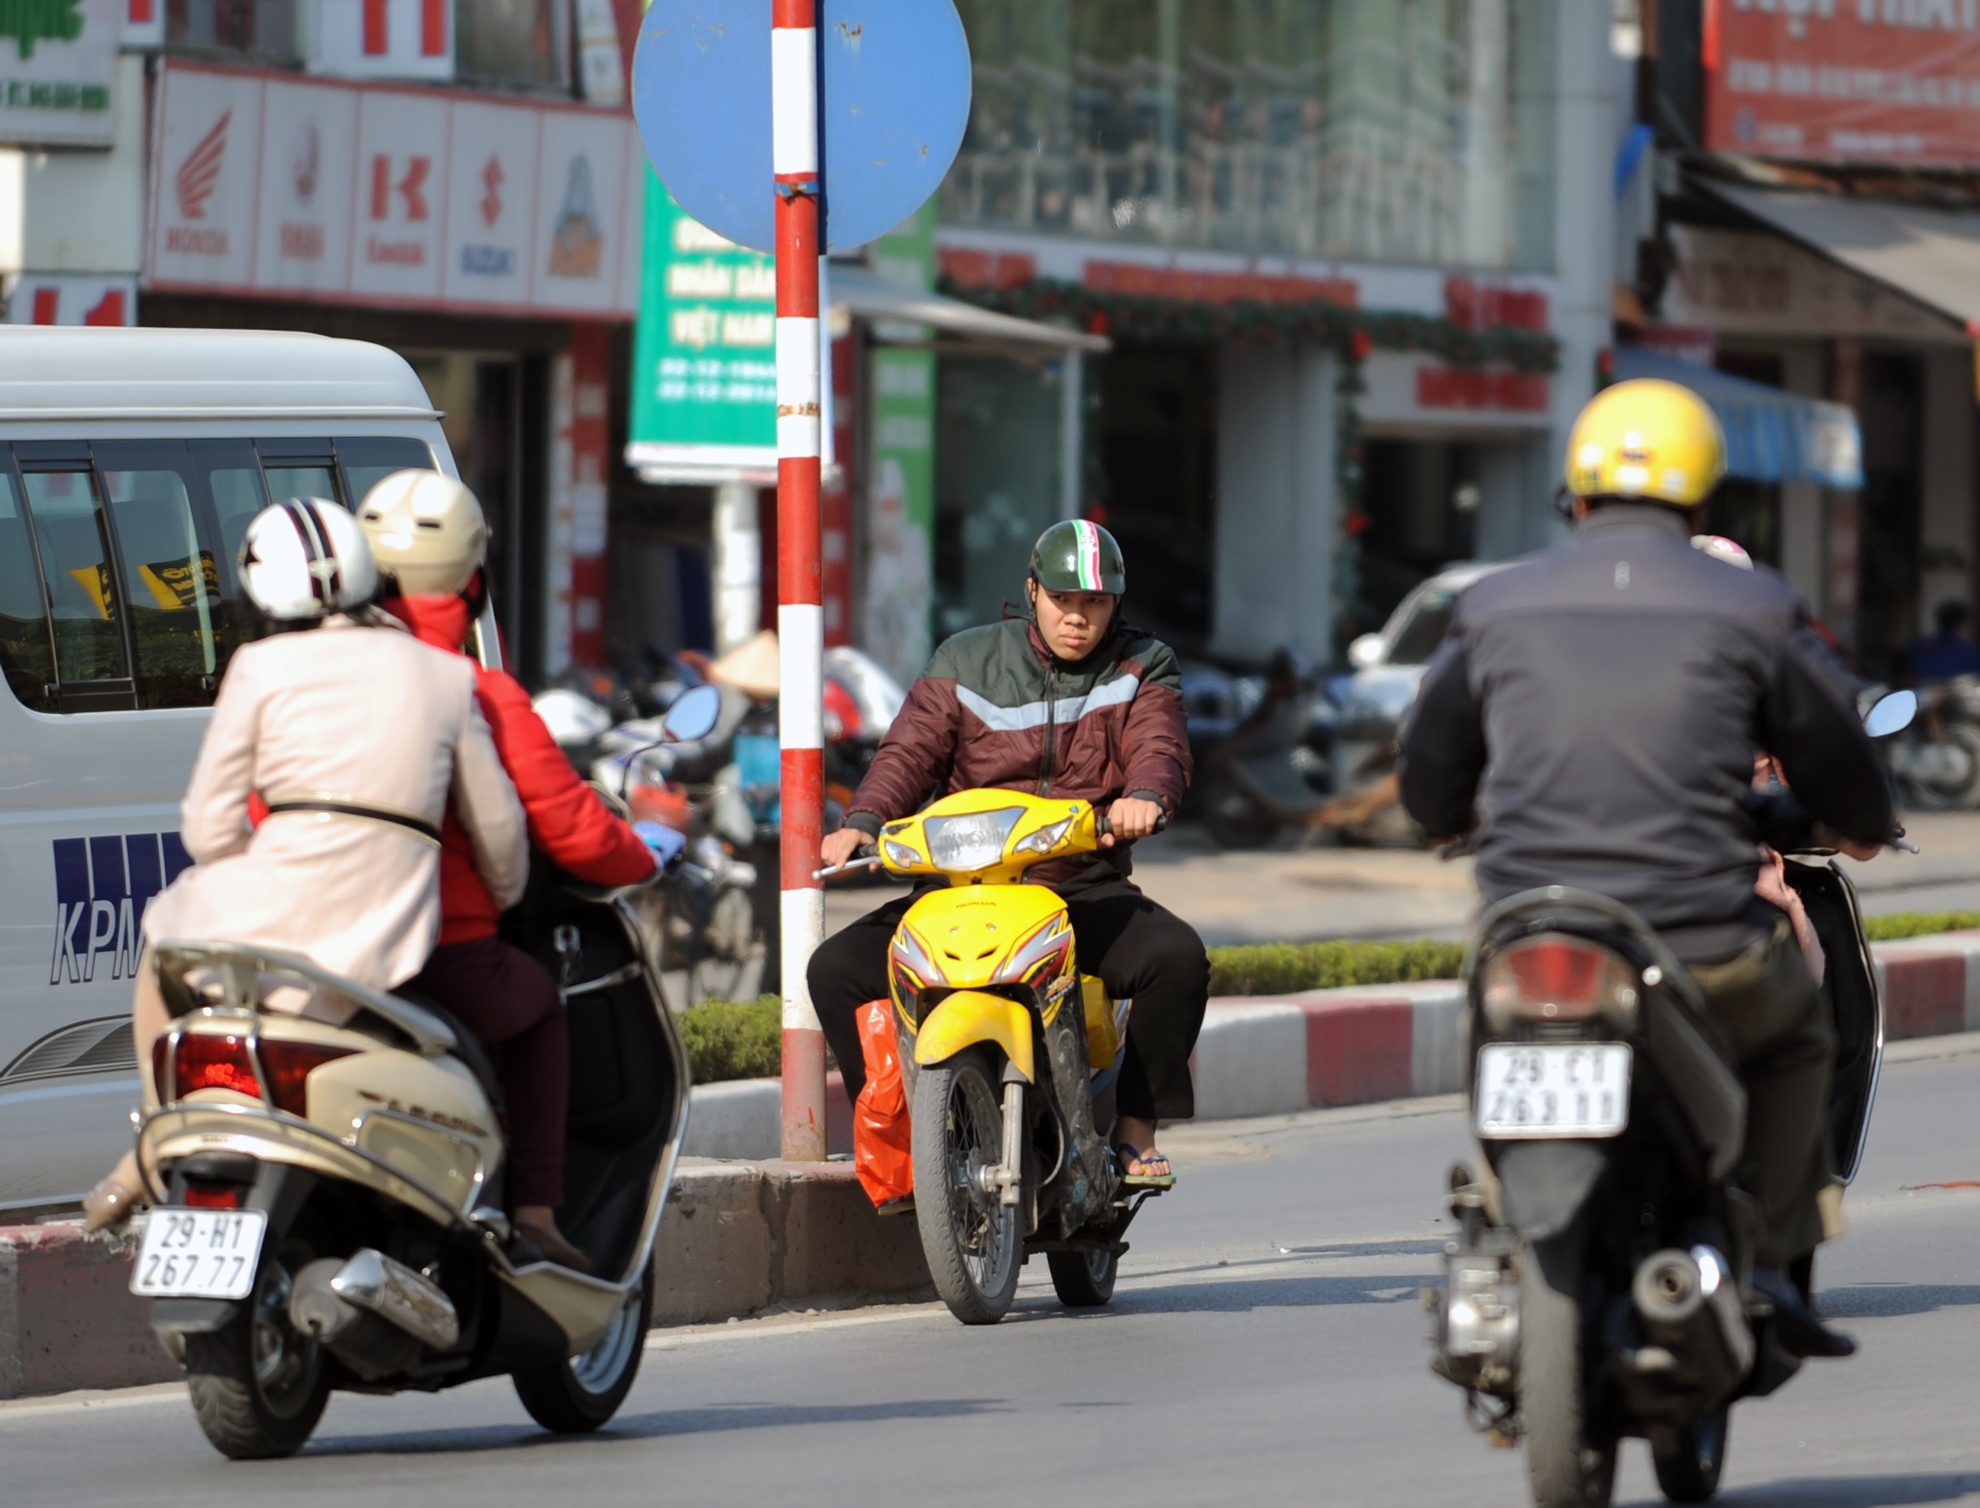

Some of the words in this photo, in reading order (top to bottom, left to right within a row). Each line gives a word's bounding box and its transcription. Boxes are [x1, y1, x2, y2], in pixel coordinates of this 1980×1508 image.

[723, 311, 775, 347] NAM
[160, 1214, 243, 1250] 29-H1
[142, 1253, 246, 1288] 267.77
